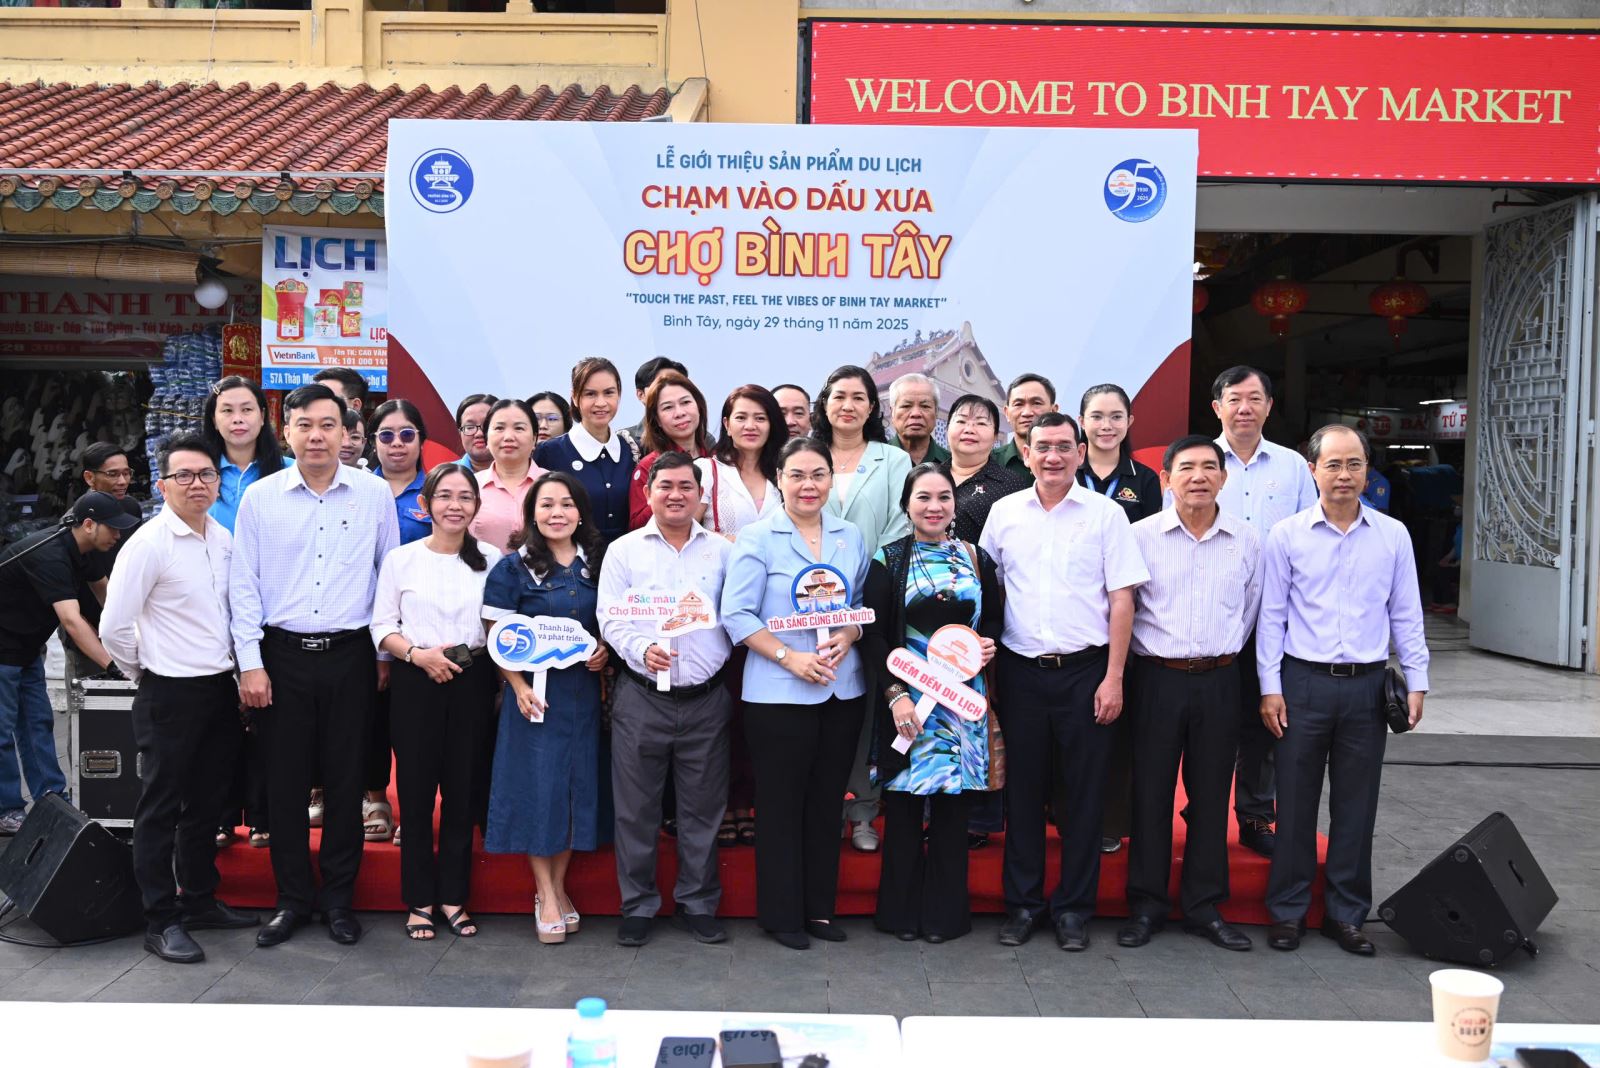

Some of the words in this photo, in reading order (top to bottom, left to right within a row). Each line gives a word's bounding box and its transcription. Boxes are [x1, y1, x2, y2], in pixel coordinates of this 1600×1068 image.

[846, 77, 1075, 117] WELCOME
[1088, 81, 1147, 118] TO
[1159, 82, 1270, 119] BINH
[1282, 84, 1368, 121] TAY
[1378, 86, 1572, 125] MARKET
[656, 145, 675, 168] LỄ
[680, 150, 712, 169] GIỚI
[717, 150, 763, 173] THIỆU
[769, 150, 801, 170] SẢN
[806, 147, 853, 171] PHẨM
[859, 157, 881, 171] DU
[886, 157, 922, 175] LỊCH
[641, 184, 730, 216] CHẠM
[736, 180, 799, 211] VÀO
[806, 179, 867, 212] DẤU
[874, 187, 934, 213] XƯA
[274, 235, 376, 279] LỊCH
[624, 227, 724, 286] CHỢ
[735, 216, 849, 277] BÌNH
[862, 220, 953, 280] TÂY
[0, 290, 151, 317] THANH
[673, 293, 695, 305] THE
[698, 294, 729, 306] PAST,
[732, 295, 758, 306] FEEL
[761, 295, 783, 306] THE
[786, 296, 818, 307] VIBES
[822, 296, 836, 307] OF
[839, 297, 866, 307] BINH
[869, 297, 890, 308] TAY
[663, 315, 692, 327] Bình
[696, 315, 722, 330] Tây,
[726, 316, 760, 331] ngày
[764, 316, 780, 328] 29
[783, 317, 824, 332] tháng
[828, 317, 839, 329] 11
[842, 318, 873, 330] năm
[876, 318, 909, 330] 2025
[370, 327, 387, 343] LỊC
[274, 351, 316, 360] VietinBank
[270, 372, 283, 384] 57A
[284, 372, 301, 386] Tháp
[1442, 411, 1458, 428] TỨ
[786, 614, 808, 629] SÁNG
[809, 611, 831, 627] CÙNG
[919, 672, 942, 693] ĐẾN
[941, 686, 959, 702] DU
[957, 695, 983, 717] LỊCH
